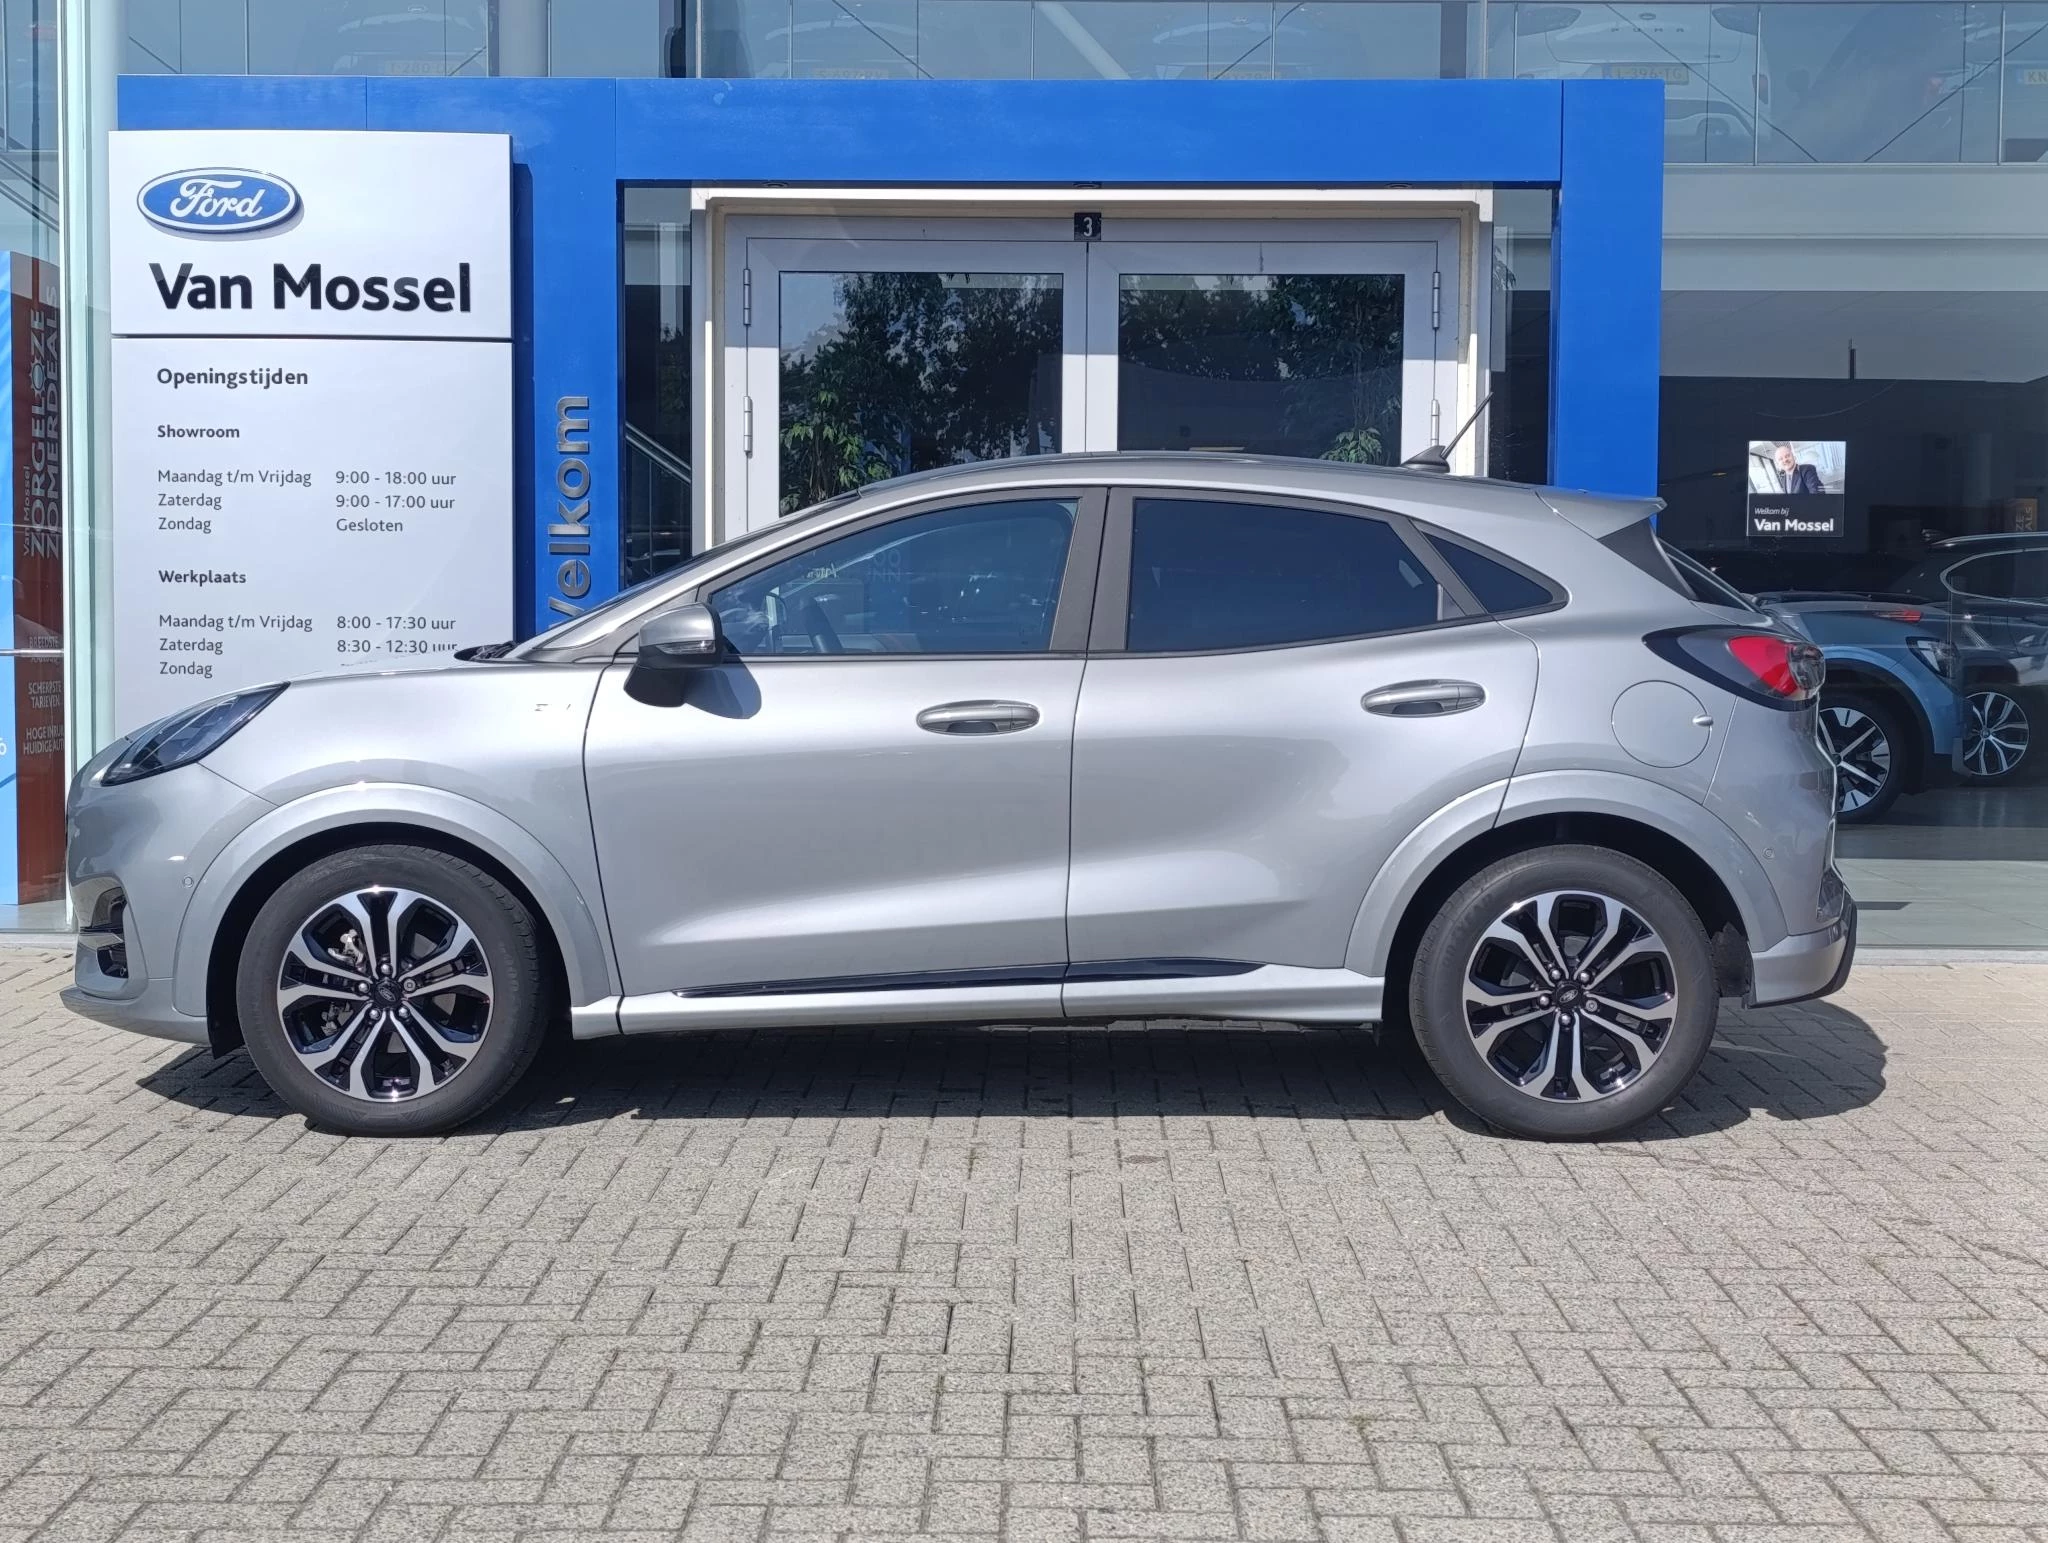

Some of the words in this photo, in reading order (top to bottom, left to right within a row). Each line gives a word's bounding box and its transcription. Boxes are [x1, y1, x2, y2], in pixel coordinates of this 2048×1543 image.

[169, 178, 266, 218] Ford
[1083, 216, 1093, 237] 3
[148, 262, 253, 311] Van
[272, 261, 472, 314] Mossel
[156, 367, 309, 390] Openingstijden
[46, 286, 59, 560] ZOMERDEALS
[157, 423, 240, 439] Showroom
[157, 468, 224, 487] Maandag
[226, 469, 254, 484] t/m
[257, 469, 312, 488] Vrijdag
[335, 470, 370, 484] 9:00
[384, 471, 427, 485] 18:00
[431, 475, 457, 486] uur
[23, 466, 31, 521] Mossel
[157, 492, 223, 511] Zaterdag
[335, 494, 370, 508] 9:00
[384, 494, 426, 509] 17:00
[430, 498, 456, 509] uur
[158, 515, 212, 535] Zondag
[336, 517, 404, 532] Gesloten
[1754, 518, 1781, 532] Van
[1784, 517, 1834, 532] Mossel
[23, 528, 31, 556] Van
[157, 569, 247, 588] Werkplaats
[159, 614, 225, 632] Maandag
[227, 614, 255, 629] t/m
[259, 614, 313, 633] Vrijdag
[336, 615, 371, 629] 8:00
[385, 616, 427, 630] 17:30
[431, 619, 457, 630] uur
[159, 637, 224, 656] Zaterdag
[336, 639, 371, 653] 8:30
[385, 639, 428, 654] 12:30
[159, 660, 213, 679] Zondag
[25, 726, 47, 741] HOGE
